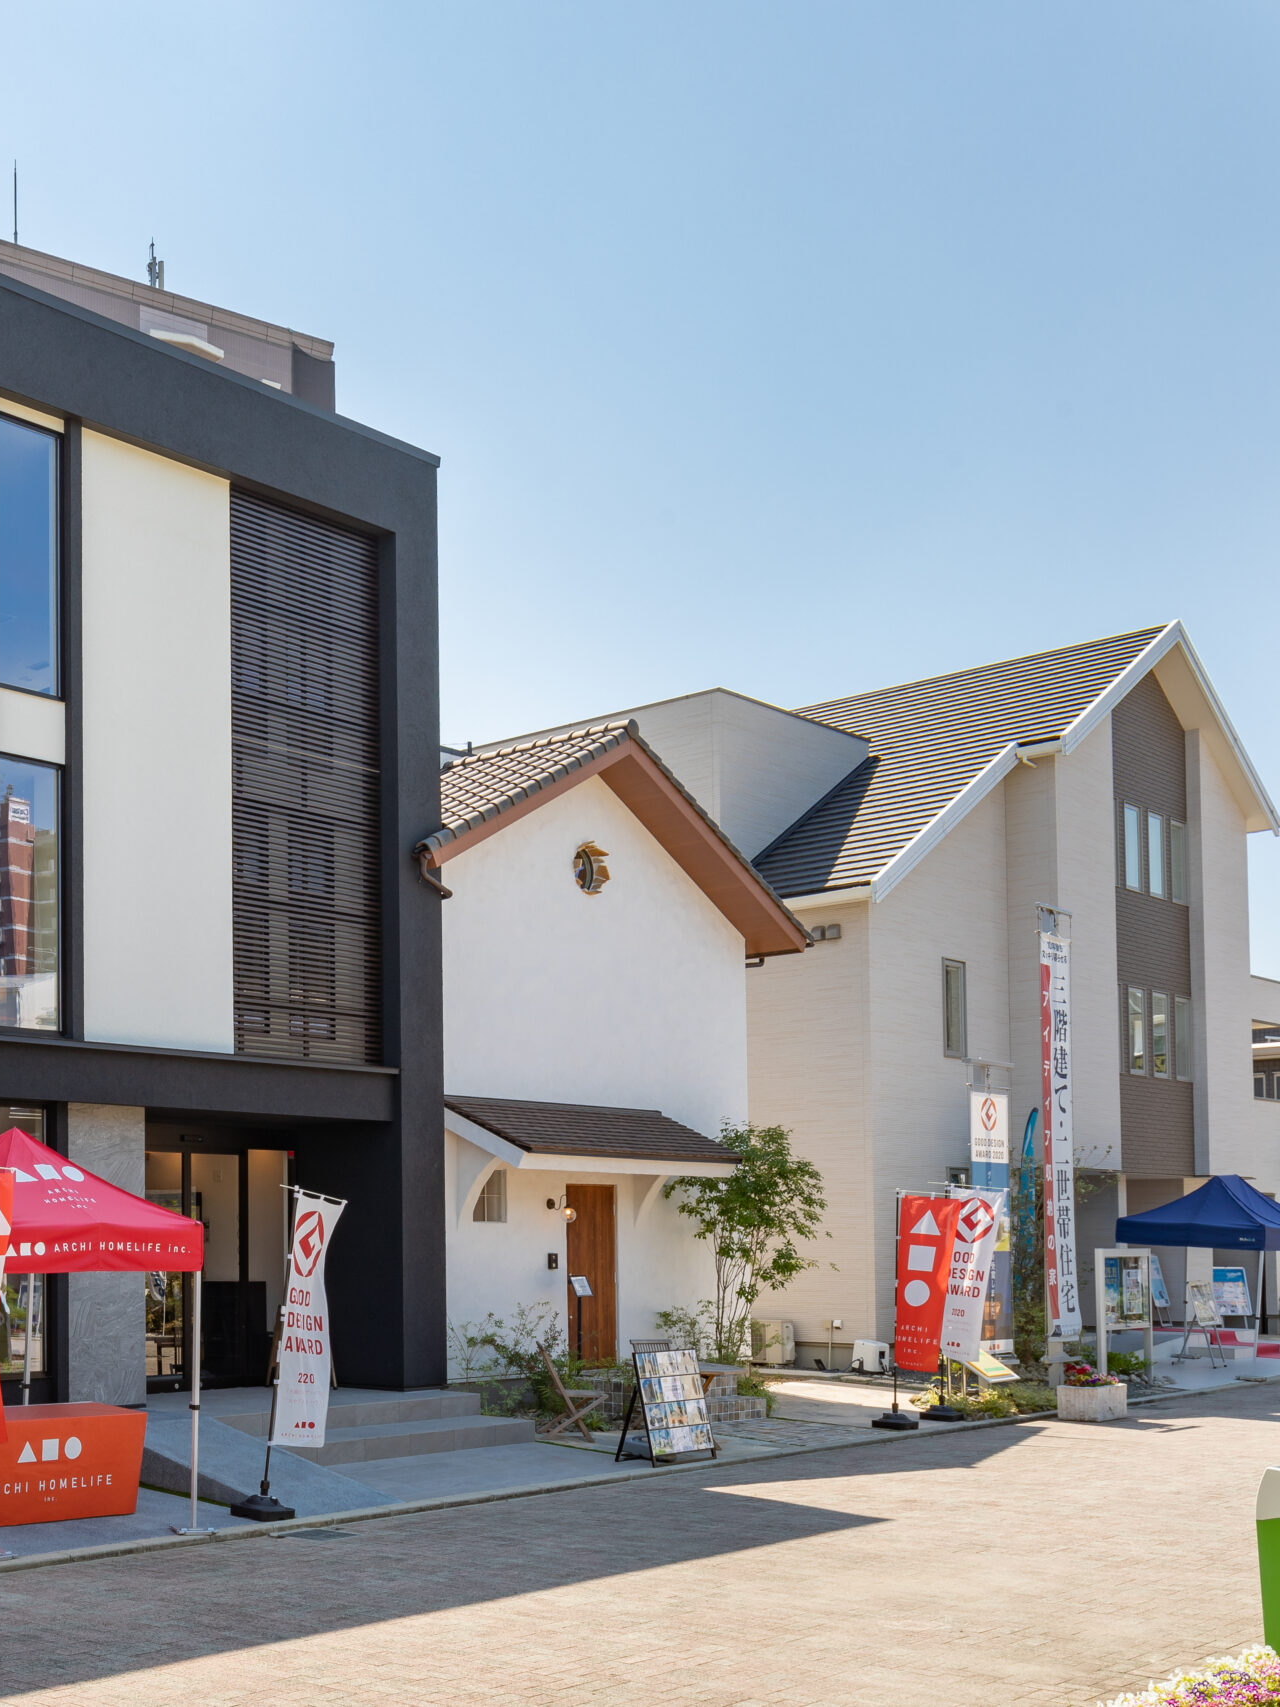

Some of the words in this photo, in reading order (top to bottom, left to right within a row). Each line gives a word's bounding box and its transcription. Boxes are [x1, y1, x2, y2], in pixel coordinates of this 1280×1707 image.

[974, 1137, 987, 1147] GOOD
[987, 1138, 1005, 1148] DESIGN
[1042, 990, 1057, 1287] アイディア収納の家
[1052, 974, 1076, 1313] 三階建て・二世帯住宅
[975, 1149, 991, 1159] AWARD
[992, 1150, 1004, 1160] 2020
[47, 1187, 79, 1196] ARCHI
[43, 1195, 97, 1205] HOMELIFE
[54, 1242, 92, 1252] ARCHI
[99, 1241, 161, 1252] HOMELIFE
[168, 1244, 191, 1254] inc.
[953, 1251, 975, 1264] OOD
[900, 1324, 928, 1333] ARCHI
[39, 1474, 113, 1491] HOMELIFE
